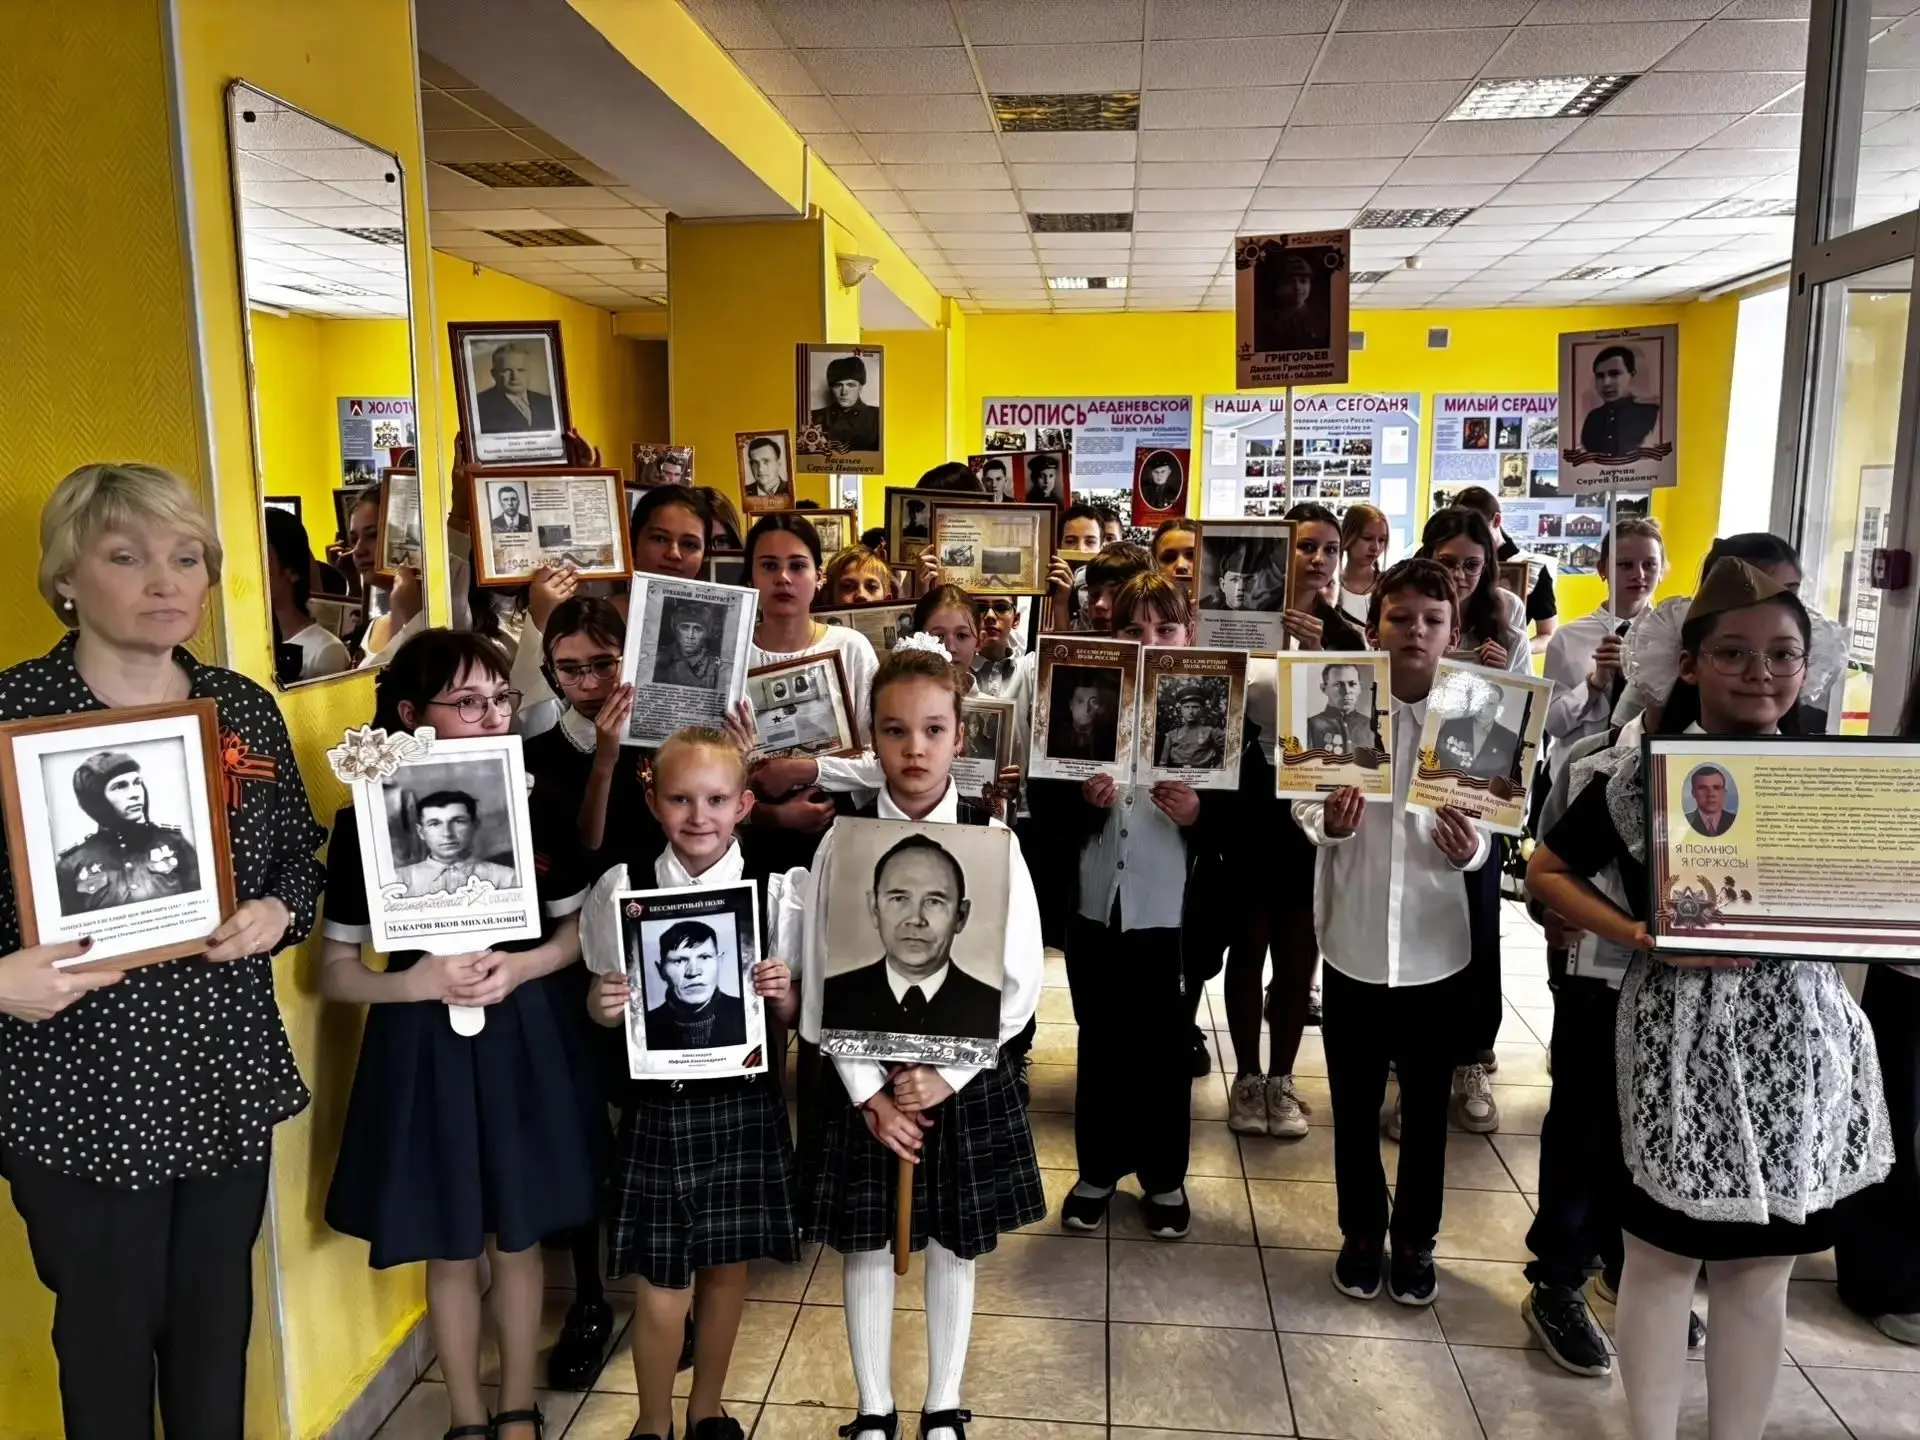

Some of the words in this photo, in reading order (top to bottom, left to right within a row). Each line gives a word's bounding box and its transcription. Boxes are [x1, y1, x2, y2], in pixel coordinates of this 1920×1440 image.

[1264, 351, 1329, 363] ГРИГОРЬЕВ
[1087, 398, 1189, 414] ДЕДЕНЕВСКОЙ
[1215, 399, 1262, 413] НАША
[1270, 398, 1328, 413] ШОЛА
[1336, 398, 1409, 413] СЕГОДНЯ
[1444, 396, 1498, 412] МИЛЫЙ
[1502, 397, 1558, 413] СЕРДЦУ
[985, 404, 1087, 426] ЛЕТОПИСЬ
[1111, 413, 1165, 425] ШКОЛЫ
[807, 464, 833, 473] Сергей
[1599, 468, 1635, 477] Анучин
[1576, 475, 1610, 486] Сергей
[1611, 474, 1658, 484] Павлович
[1076, 648, 1120, 656] БЕССМЕРТНЫЙ
[1675, 844, 1682, 853] Я
[1685, 844, 1738, 855] ПОМНЮ!
[1681, 857, 1688, 867] Я
[1691, 857, 1749, 868] ГОРЖУСЬ!
[649, 901, 704, 912] БЕССМЕРТНЫЙ
[705, 899, 726, 907] ПОЛК
[388, 922, 432, 932] МАКАРОВ
[434, 920, 459, 929] ЯКОВ
[461, 915, 525, 927] МИХАЙЛОВИЧ
